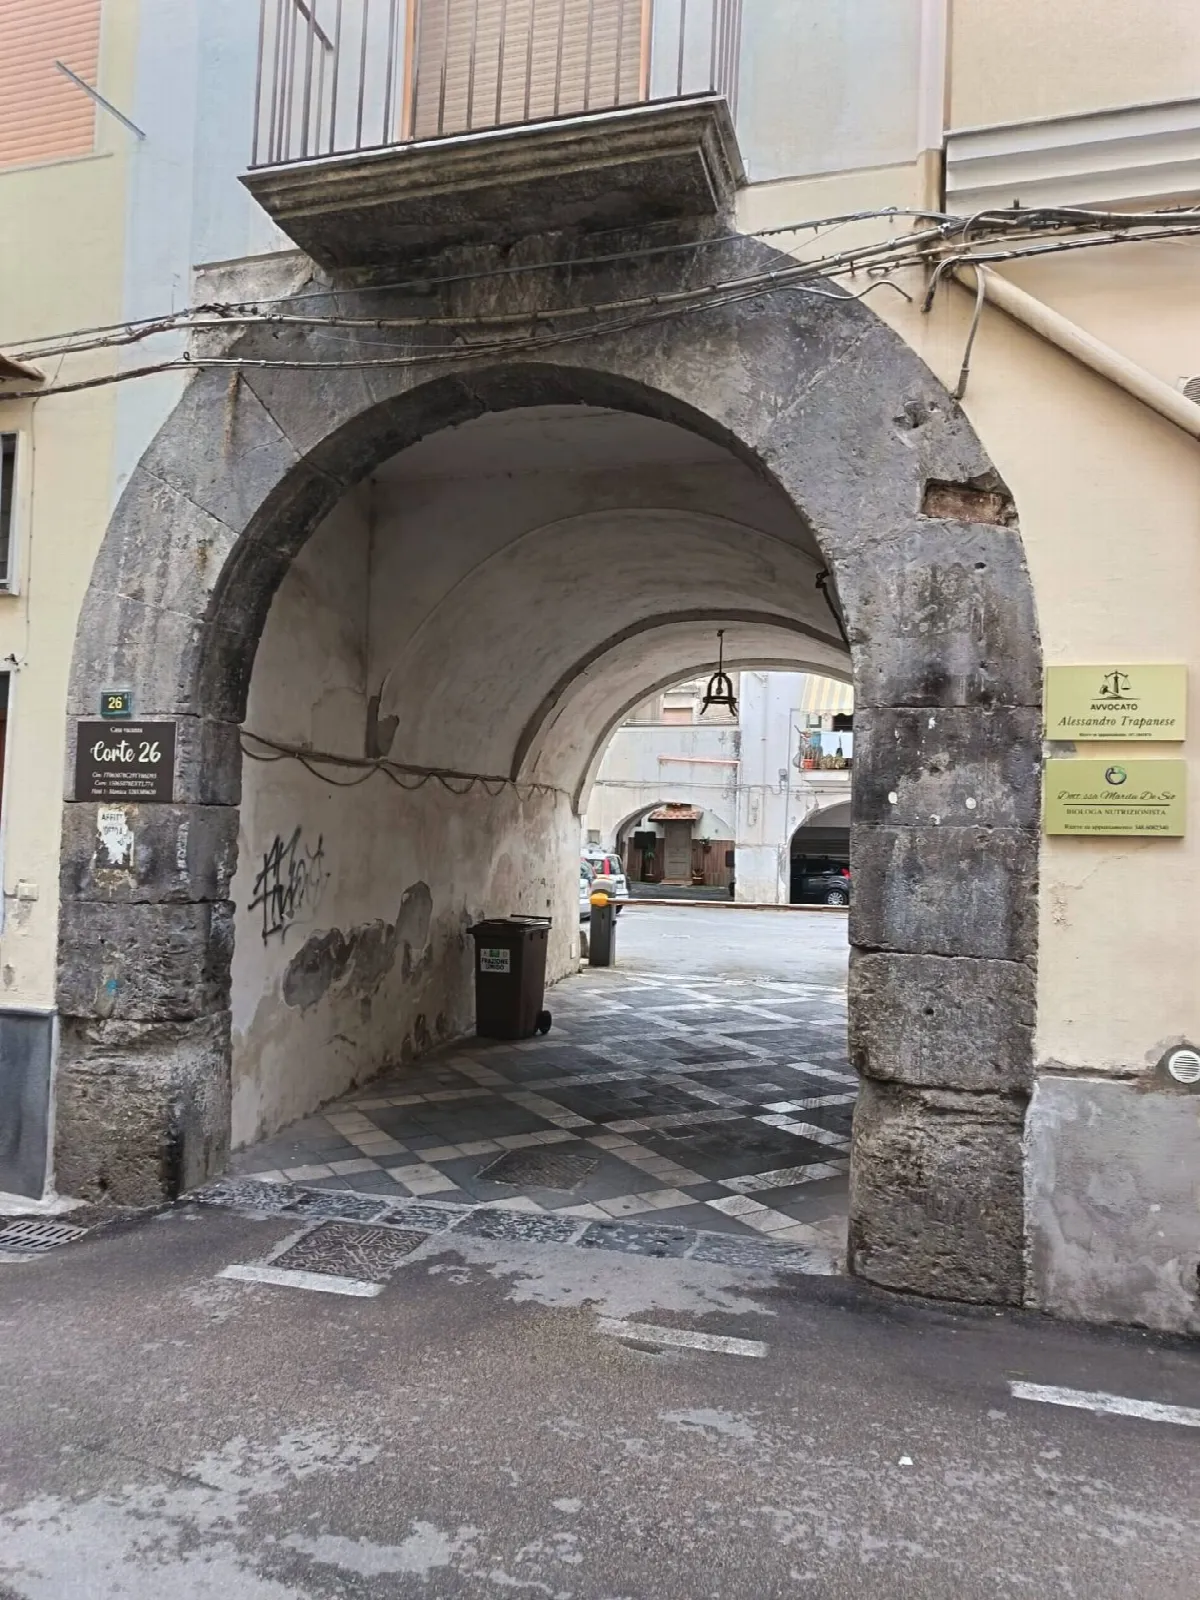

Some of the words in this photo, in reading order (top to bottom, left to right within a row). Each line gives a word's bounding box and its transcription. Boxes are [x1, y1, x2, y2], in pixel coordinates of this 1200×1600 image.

[108, 696, 122, 709] 26
[1090, 703, 1138, 711] AVVOCATO
[1058, 716, 1117, 727] Alessandro
[1121, 716, 1176, 729] Trapanese
[90, 740, 136, 762] Corte
[138, 741, 162, 763] 26
[102, 813, 124, 821] AFFITT
